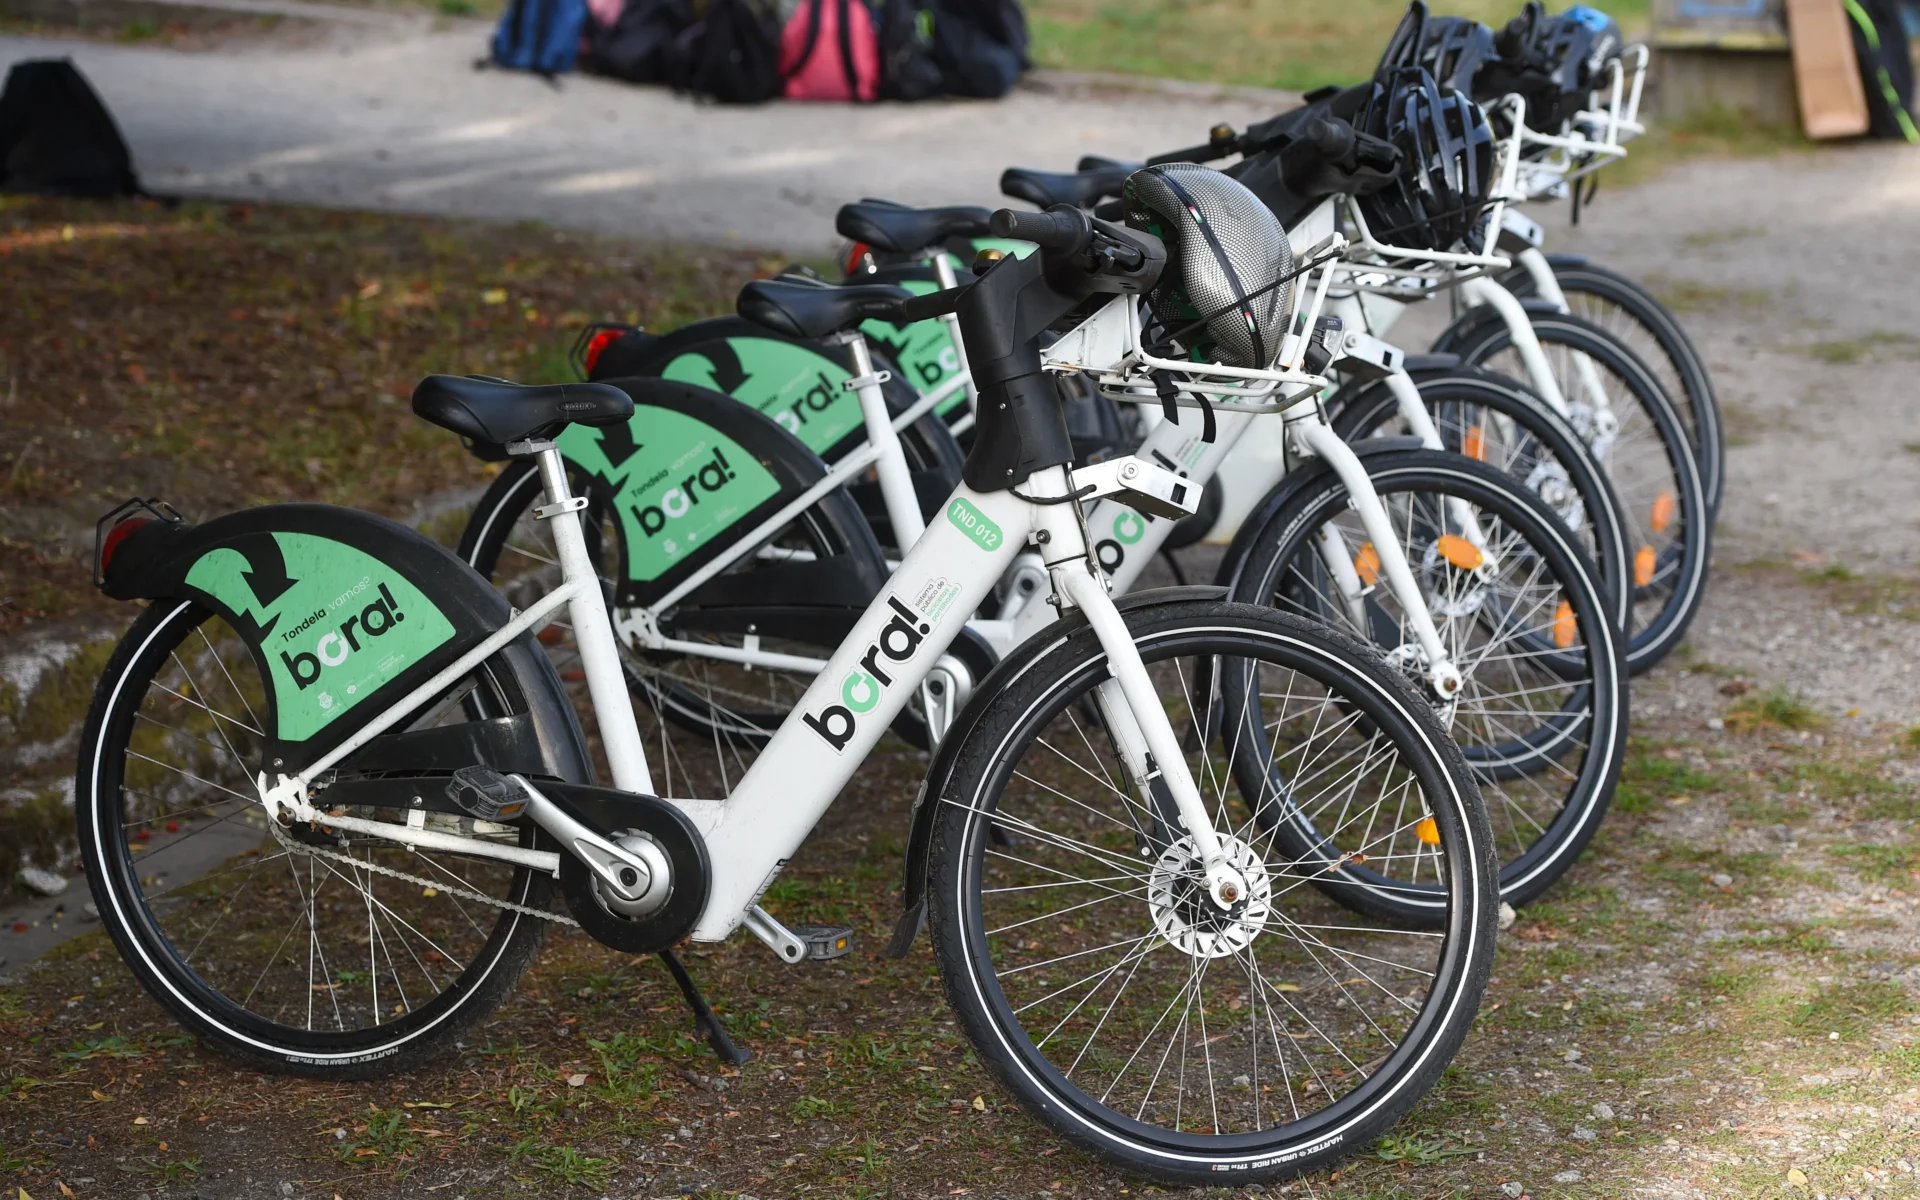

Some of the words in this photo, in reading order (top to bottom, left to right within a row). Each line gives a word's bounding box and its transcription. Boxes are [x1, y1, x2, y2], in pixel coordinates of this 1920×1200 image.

[630, 446, 737, 538] bora!
[952, 500, 977, 530] TND
[974, 523, 998, 548] 012
[328, 575, 371, 611] vamos?
[914, 582, 935, 608] sistema
[920, 588, 939, 613] público
[935, 579, 946, 592] de
[925, 586, 951, 618] bicicletas
[930, 585, 960, 623] partilhadas
[280, 582, 406, 691] bora!
[802, 595, 931, 752] bora!
[313, 1057, 329, 1066] RIDE
[329, 1057, 351, 1066] URBAN
[359, 1046, 400, 1063] HARTEX
[1271, 1152, 1298, 1166] URBAN
[1307, 1134, 1344, 1156] HARTEX
[1251, 1160, 1270, 1169] RIDE
